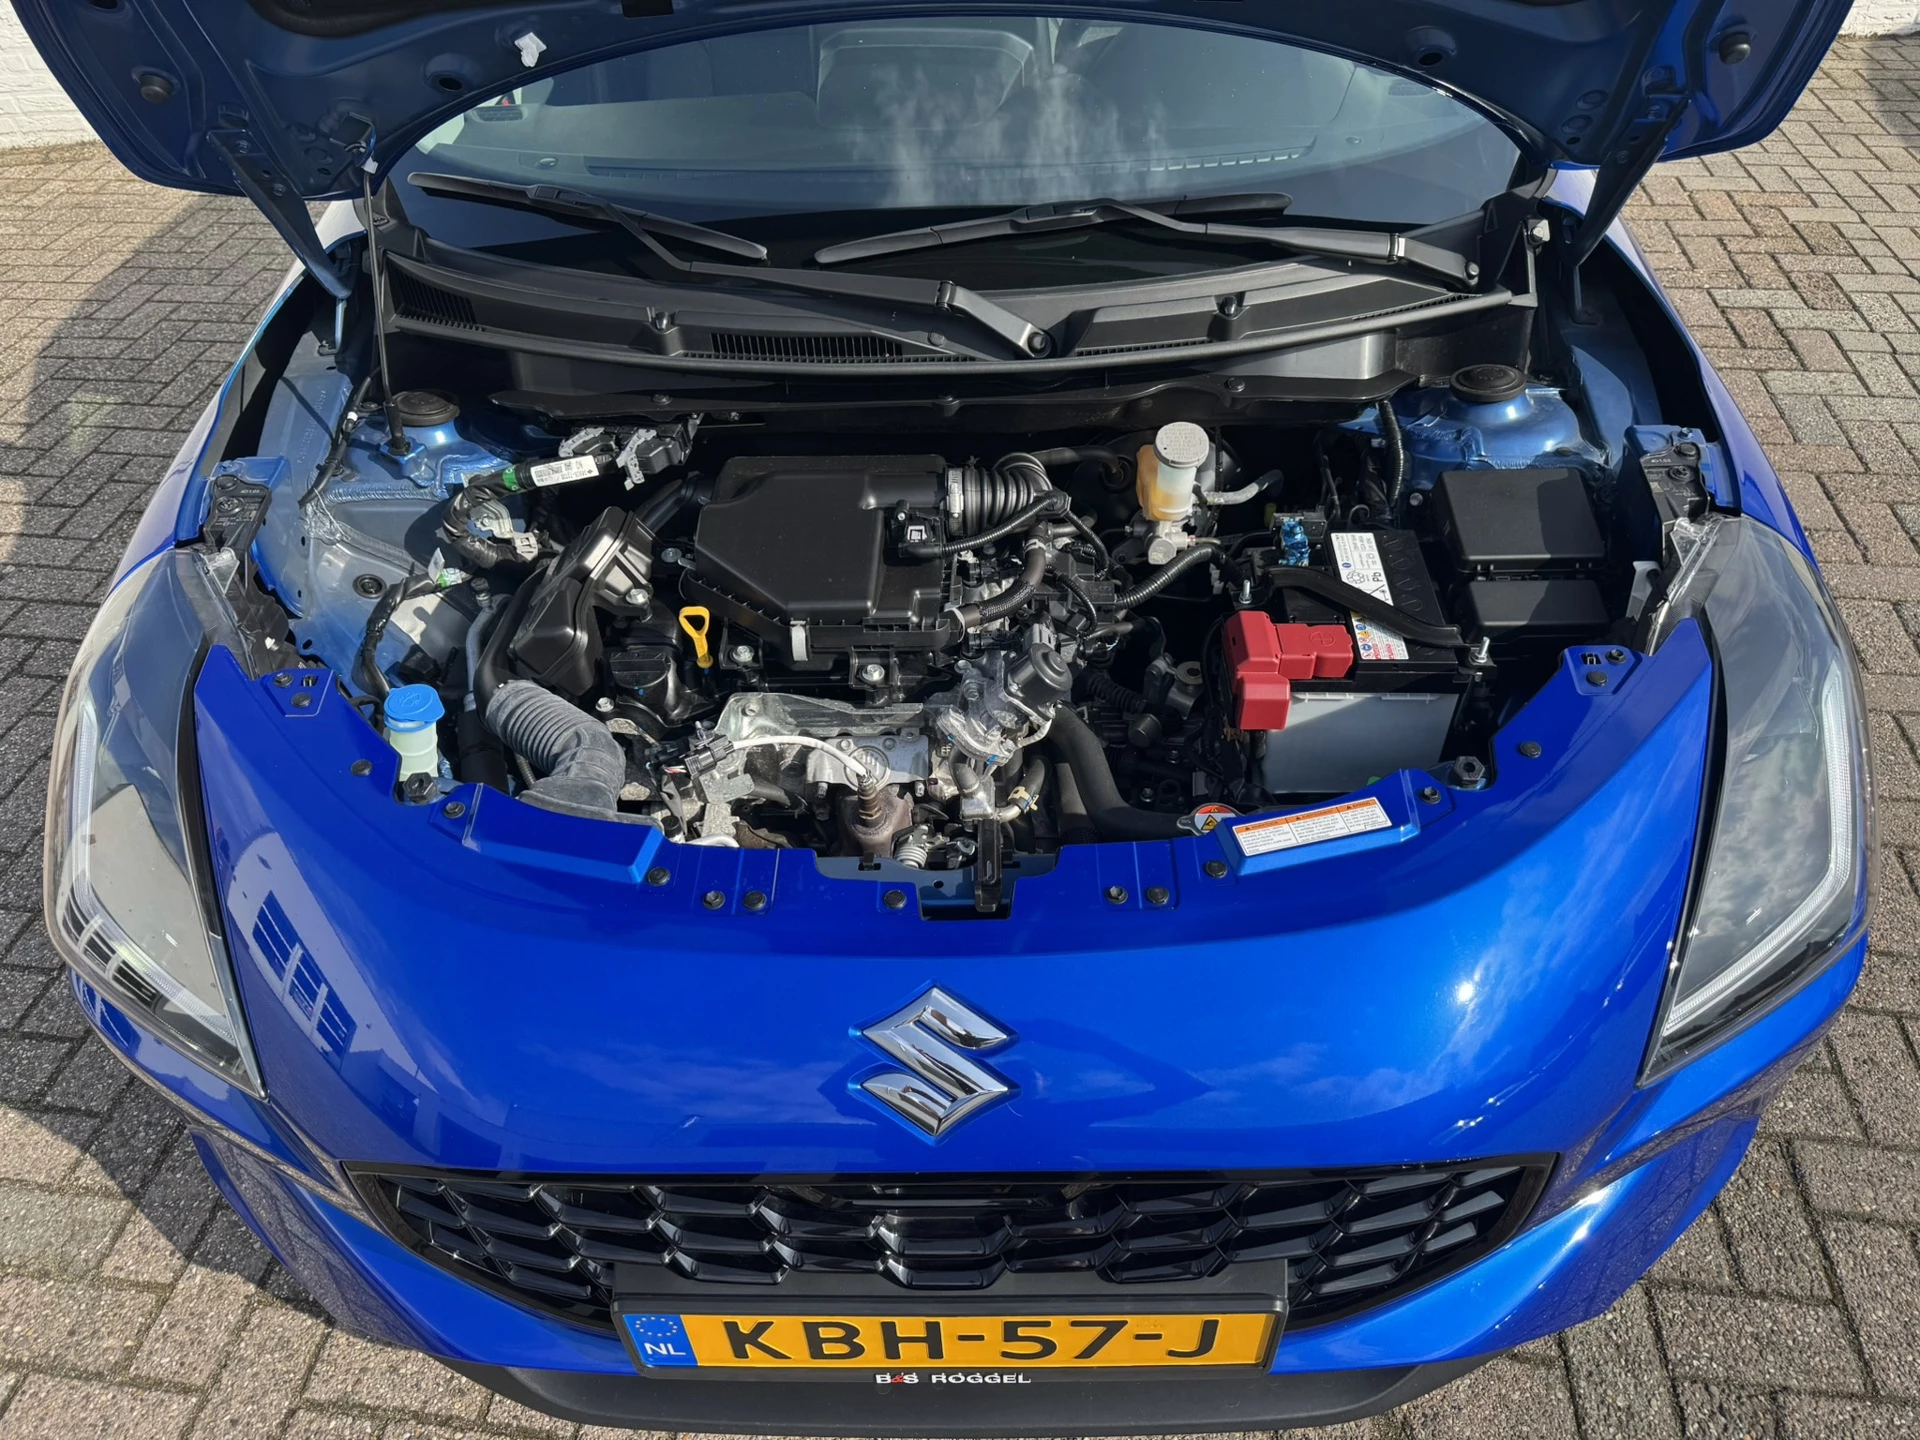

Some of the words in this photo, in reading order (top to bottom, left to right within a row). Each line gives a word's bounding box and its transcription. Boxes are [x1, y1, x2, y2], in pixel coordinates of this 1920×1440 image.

[723, 1319, 1220, 1360] KBH-57-J
[643, 1342, 686, 1356] NL
[875, 1373, 919, 1384] B&S
